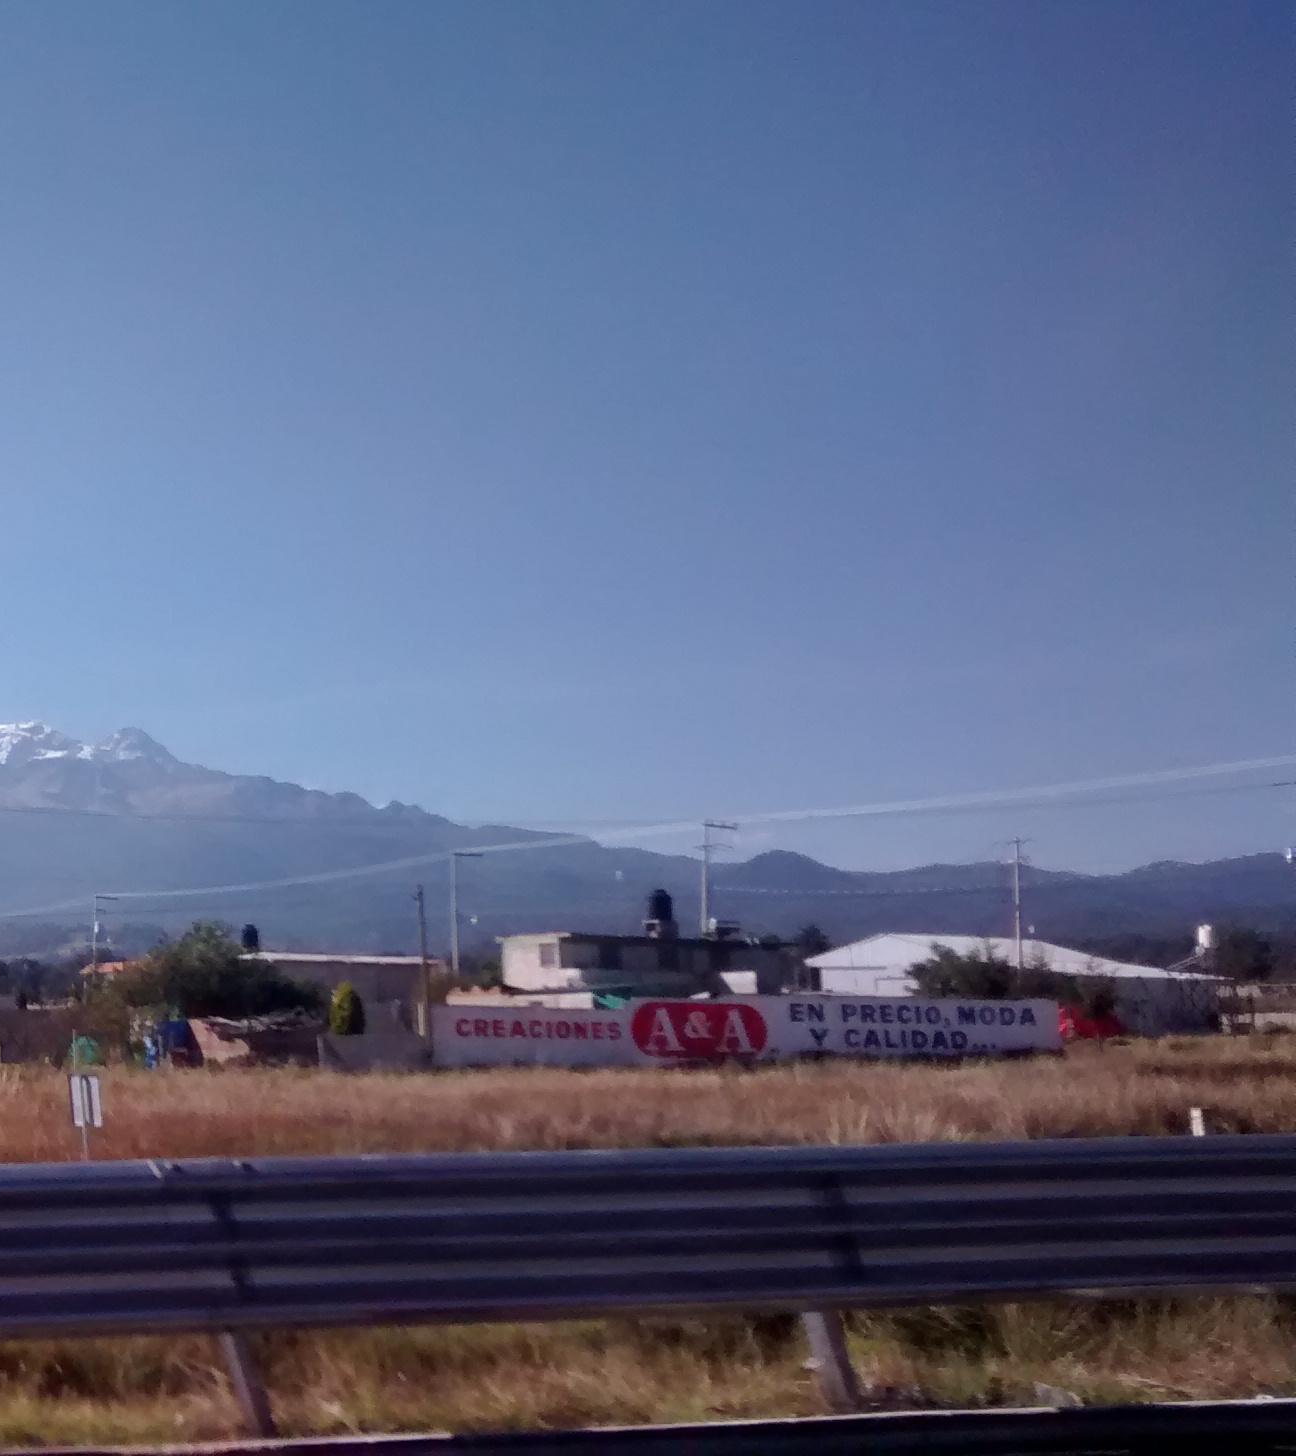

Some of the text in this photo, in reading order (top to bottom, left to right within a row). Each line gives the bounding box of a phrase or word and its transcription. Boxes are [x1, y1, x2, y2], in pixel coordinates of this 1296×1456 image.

[789, 1003, 1038, 1029] EN PRECIO, MODA
[455, 1018, 623, 1041] CREACIONES
[646, 1006, 756, 1052] A&A
[809, 1027, 829, 1047] Y
